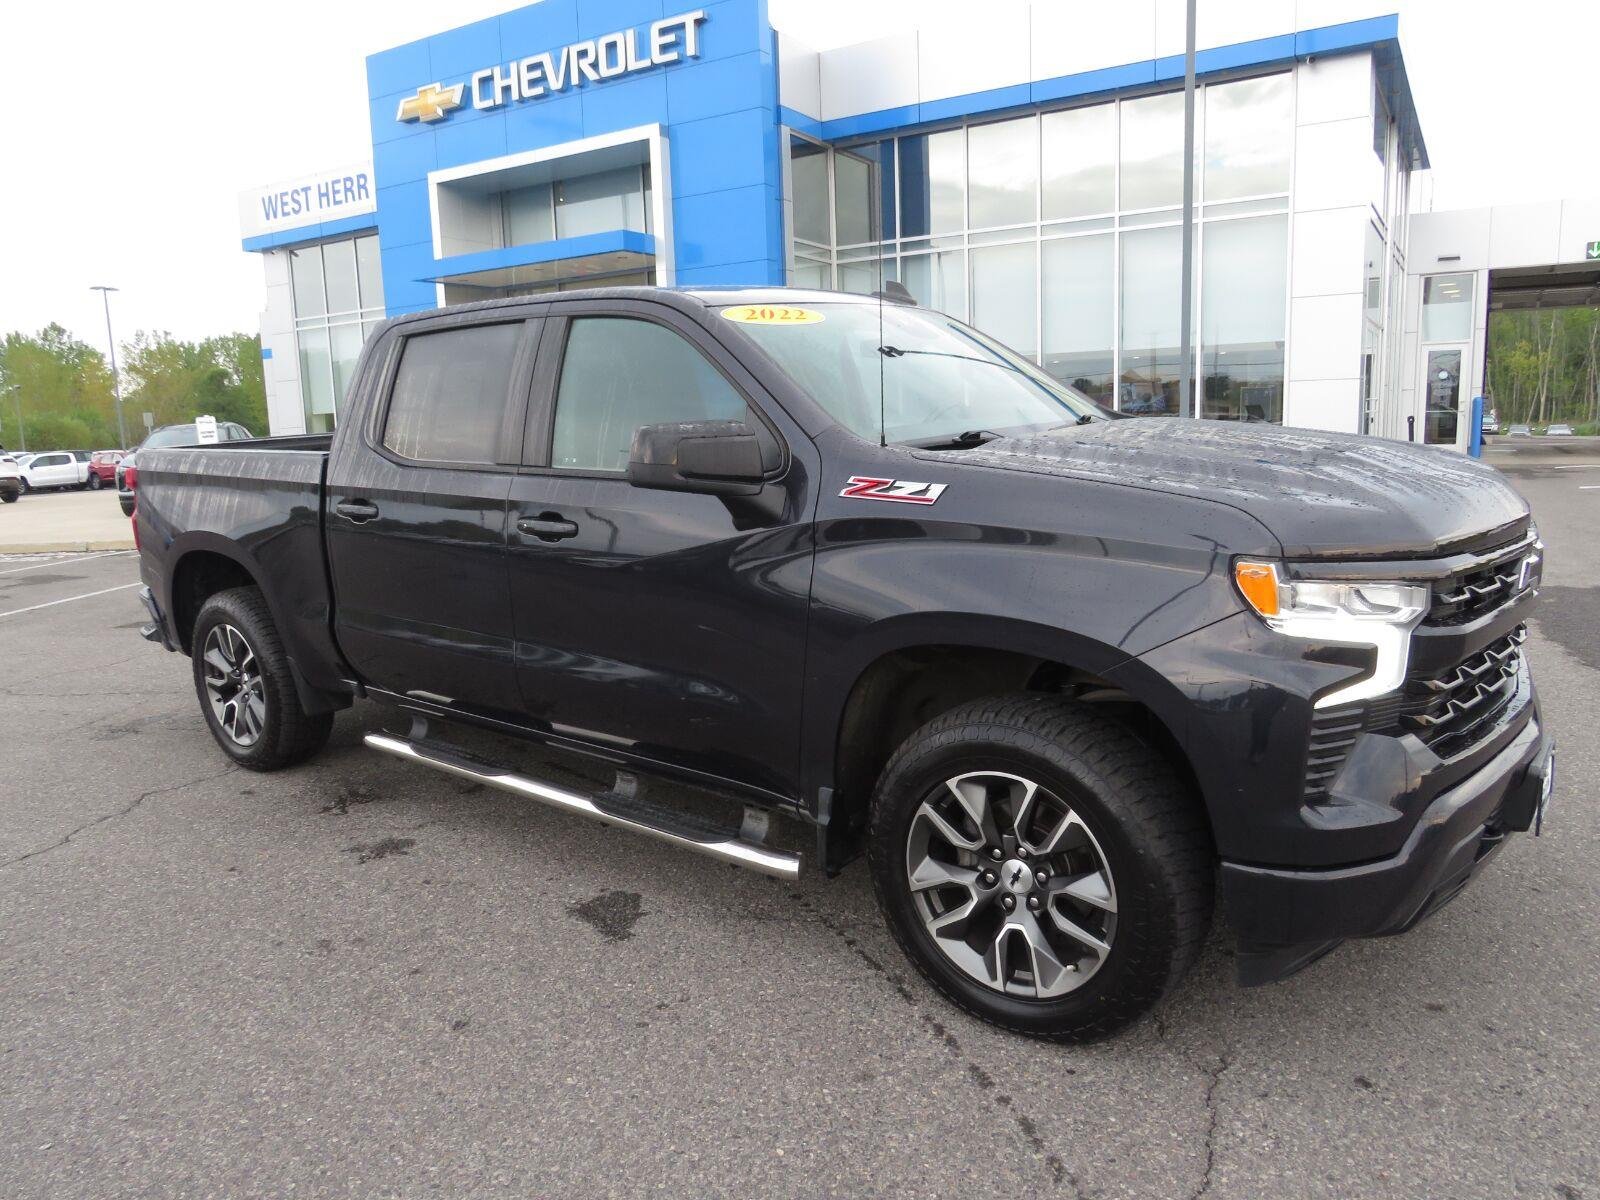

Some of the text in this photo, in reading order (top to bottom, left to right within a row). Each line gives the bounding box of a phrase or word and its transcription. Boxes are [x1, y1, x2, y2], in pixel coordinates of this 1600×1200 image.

[471, 9, 707, 111] CHEVROLET
[261, 173, 370, 221] WEST HERR
[745, 308, 807, 321] 2022
[838, 475, 949, 505] Z71
